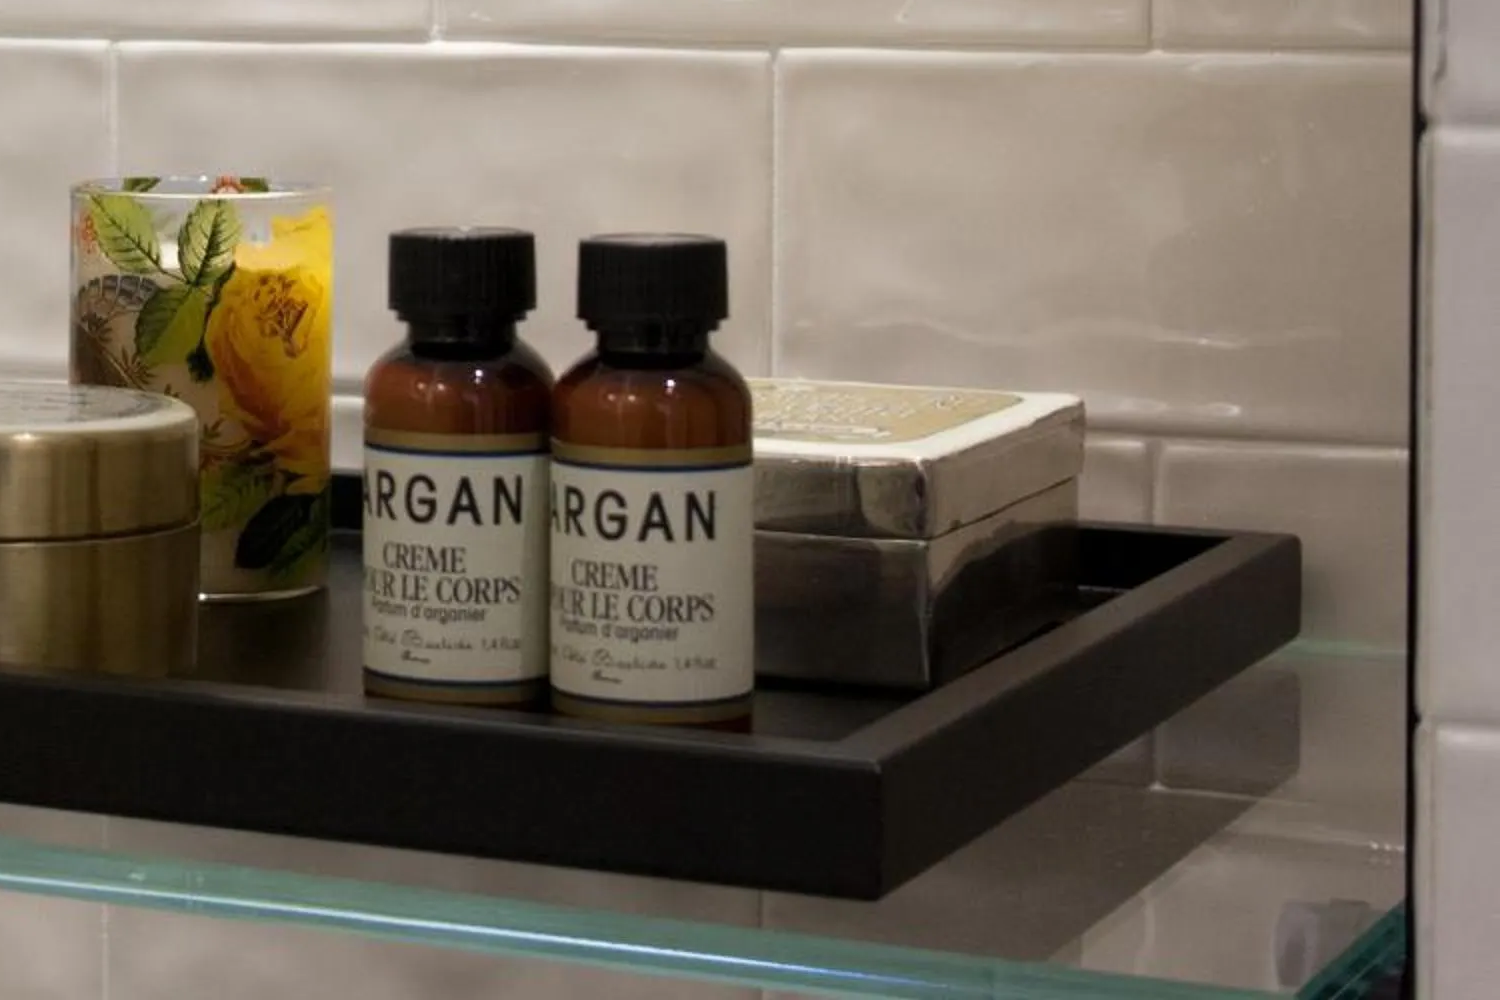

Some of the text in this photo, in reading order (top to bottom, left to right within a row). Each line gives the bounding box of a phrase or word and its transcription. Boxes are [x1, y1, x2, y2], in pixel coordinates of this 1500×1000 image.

[364, 466, 522, 526] ARGAN
[550, 480, 716, 543] ARGAN
[382, 541, 467, 574] CREME
[571, 557, 659, 592] CREME
[401, 573, 429, 601] LE
[435, 575, 521, 605] CORPS
[591, 590, 619, 620] LE
[627, 592, 715, 623] CORPS
